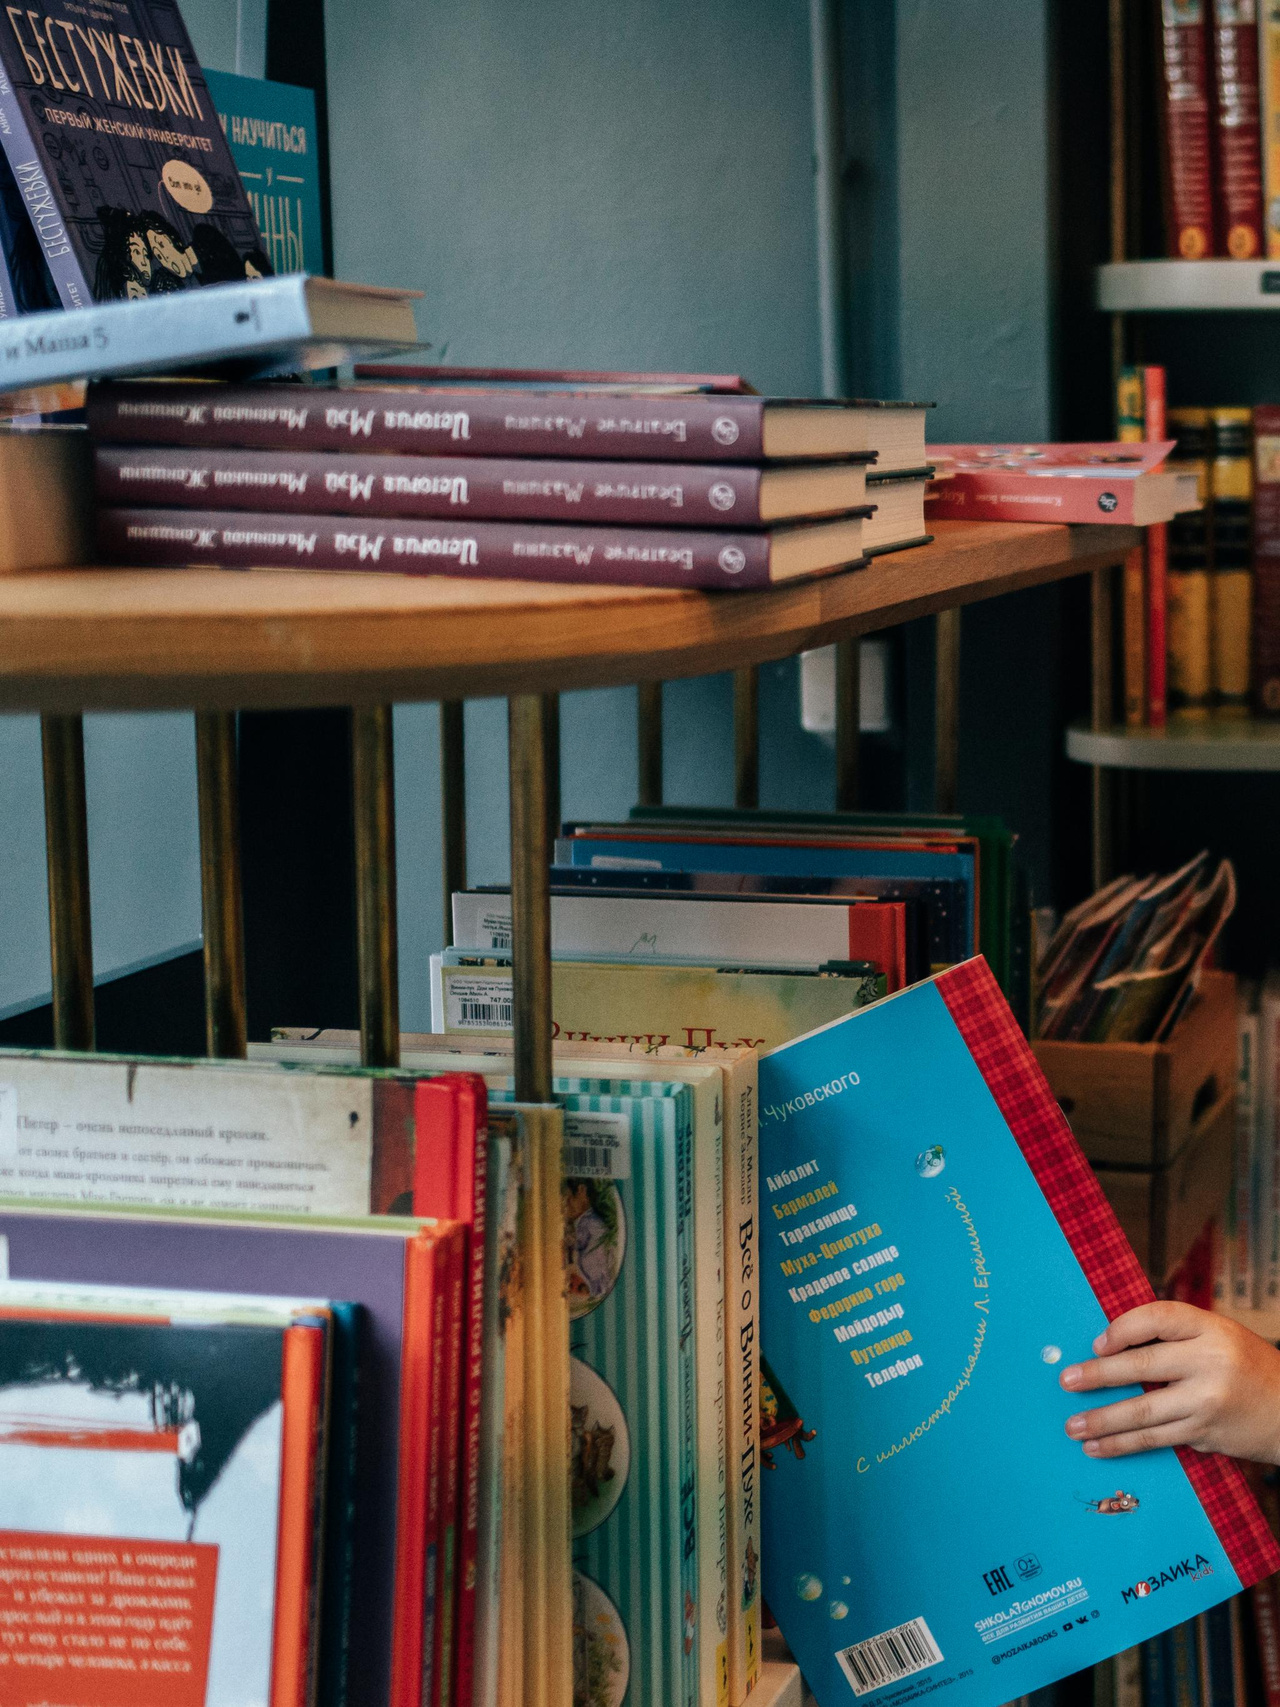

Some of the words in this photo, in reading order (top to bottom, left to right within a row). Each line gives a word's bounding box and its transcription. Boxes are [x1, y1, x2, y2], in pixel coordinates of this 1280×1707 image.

[6, 6, 204, 121] БЕСТУЖЕВКИ
[44, 108, 92, 129] ПЕРВЫЙ
[93, 117, 145, 139] ЖЕНСКИЙ
[146, 127, 213, 152] УНИВЕРСИТЕТ
[232, 115, 306, 154] НАУЧИТЬСЯ
[15, 160, 70, 258] БЕСТУЖЕВКИ
[24, 331, 90, 357] Маша
[95, 328, 108, 350] 5
[325, 407, 375, 436] Мэй
[384, 410, 470, 439] История
[325, 471, 376, 500] Мэй
[383, 475, 470, 504] История
[333, 532, 385, 561] Мэй
[392, 536, 479, 565] История
[745, 1085, 754, 1130] Алан
[764, 1071, 861, 1123] Чуковского
[17, 1115, 59, 1134] Питер
[76, 1121, 113, 1133] очень
[119, 1123, 214, 1139] непоседливый
[73, 1147, 116, 1162] братьев
[175, 1155, 189, 1165] он
[194, 1153, 244, 1167] обожает
[766, 1159, 820, 1193] Айболит
[474, 1127, 489, 1233] ПИТЕРЕ
[745, 1157, 754, 1206] Милн
[771, 1181, 839, 1220] Бармалей
[778, 1203, 857, 1247] Тараканище
[738, 1217, 755, 1284] Всё
[780, 1222, 883, 1277] Муха-Цокотуха
[788, 1265, 850, 1303] Краденое
[852, 1245, 900, 1275] солнце
[470, 1244, 484, 1378] КРОЛИКЕ
[741, 1289, 752, 1311] о
[809, 1287, 874, 1324] Федорино
[875, 1272, 906, 1296] горе
[833, 1303, 905, 1343] Мойдодыр
[856, 1456, 871, 1474] С
[876, 1317, 988, 1464] иллюстрациями
[944, 1185, 991, 1289] Ерёминой
[850, 1328, 913, 1365] Путаница
[864, 1353, 924, 1389] Телефон
[739, 1325, 760, 1531] Винни-Пухе
[1190, 1563, 1214, 1583] kids
[974, 1577, 1083, 1632] SHKOLA7GNOMOV.RU
[1010, 1612, 1043, 1631] РАЗВИТИЯ
[1043, 1601, 1066, 1615] ВАШИХ
[991, 1630, 1058, 1665] @MOZAIKABOOKS
[958, 1668, 975, 1680] 2015
